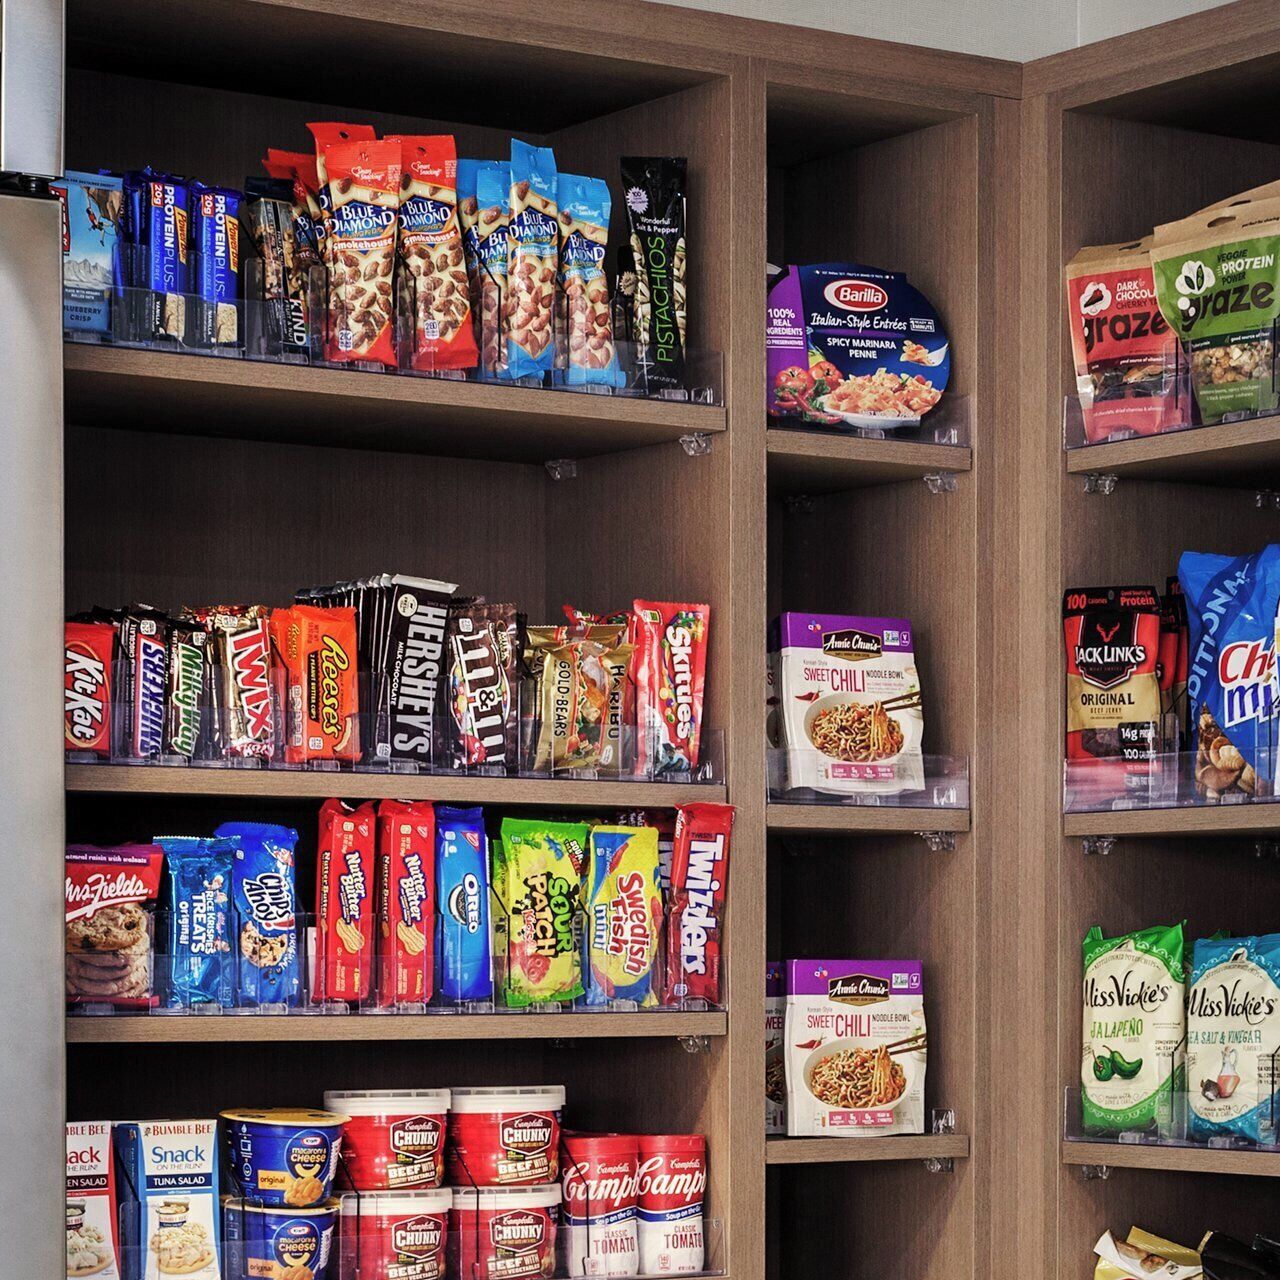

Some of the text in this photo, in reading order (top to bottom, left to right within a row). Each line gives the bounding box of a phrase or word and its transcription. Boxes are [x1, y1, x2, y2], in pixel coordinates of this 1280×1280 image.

[342, 204, 374, 220] BLUE
[406, 200, 434, 215] BLUE
[329, 210, 395, 235] DIAMOND
[523, 212, 544, 226] BLUE
[510, 220, 558, 238] DIAMOND
[404, 231, 457, 247] Smokehouse
[1222, 254, 1274, 276] PROTEIN
[1116, 281, 1139, 292] DARK
[1222, 273, 1246, 285] POWER
[647, 235, 674, 362] PISTACHIOS
[839, 287, 882, 303] Barilla
[289, 298, 307, 346] KIND
[768, 308, 795, 319] 100%
[773, 319, 792, 327] REAL
[827, 338, 896, 349] SPICY MARINARA
[849, 350, 877, 359] PENNE
[1120, 596, 1156, 606] Protein
[1075, 644, 1146, 664] JACK LINK'S
[232, 619, 273, 739] TWIX
[393, 605, 447, 754] HERSHEY'S
[666, 625, 692, 739] Skittles
[804, 667, 904, 692] SWEET CHILI NOODLE BOWL
[140, 642, 166, 757] SNICKERS
[608, 664, 625, 739] HARIBO
[1081, 692, 1135, 707] ORIGINAL
[346, 852, 366, 899] Nutter
[405, 854, 427, 900] Nutter
[341, 875, 359, 919] Butter
[401, 877, 422, 921] Butter
[463, 873, 479, 934] OREO
[191, 891, 206, 953] TREATS
[529, 874, 556, 956] PATCH
[549, 877, 573, 953] SOUR
[618, 872, 648, 974] Swedish
[609, 901, 629, 954] Fish
[807, 1014, 910, 1037] SWEET CHILI NOODLE BOWL
[394, 1131, 439, 1147] CHUNKY
[503, 1128, 551, 1143] CHUNKY
[152, 1146, 205, 1163] Snack
[81, 1178, 106, 1187] SALAD
[154, 1176, 205, 1186] TUNA SALAD
[260, 1176, 286, 1185] original
[396, 1230, 441, 1246] CHUNKY
[495, 1224, 542, 1240] CHUNKY
[674, 1225, 696, 1233] CLASSIC
[594, 1237, 635, 1255] TOMATO
[664, 1233, 702, 1249] TOMATO
